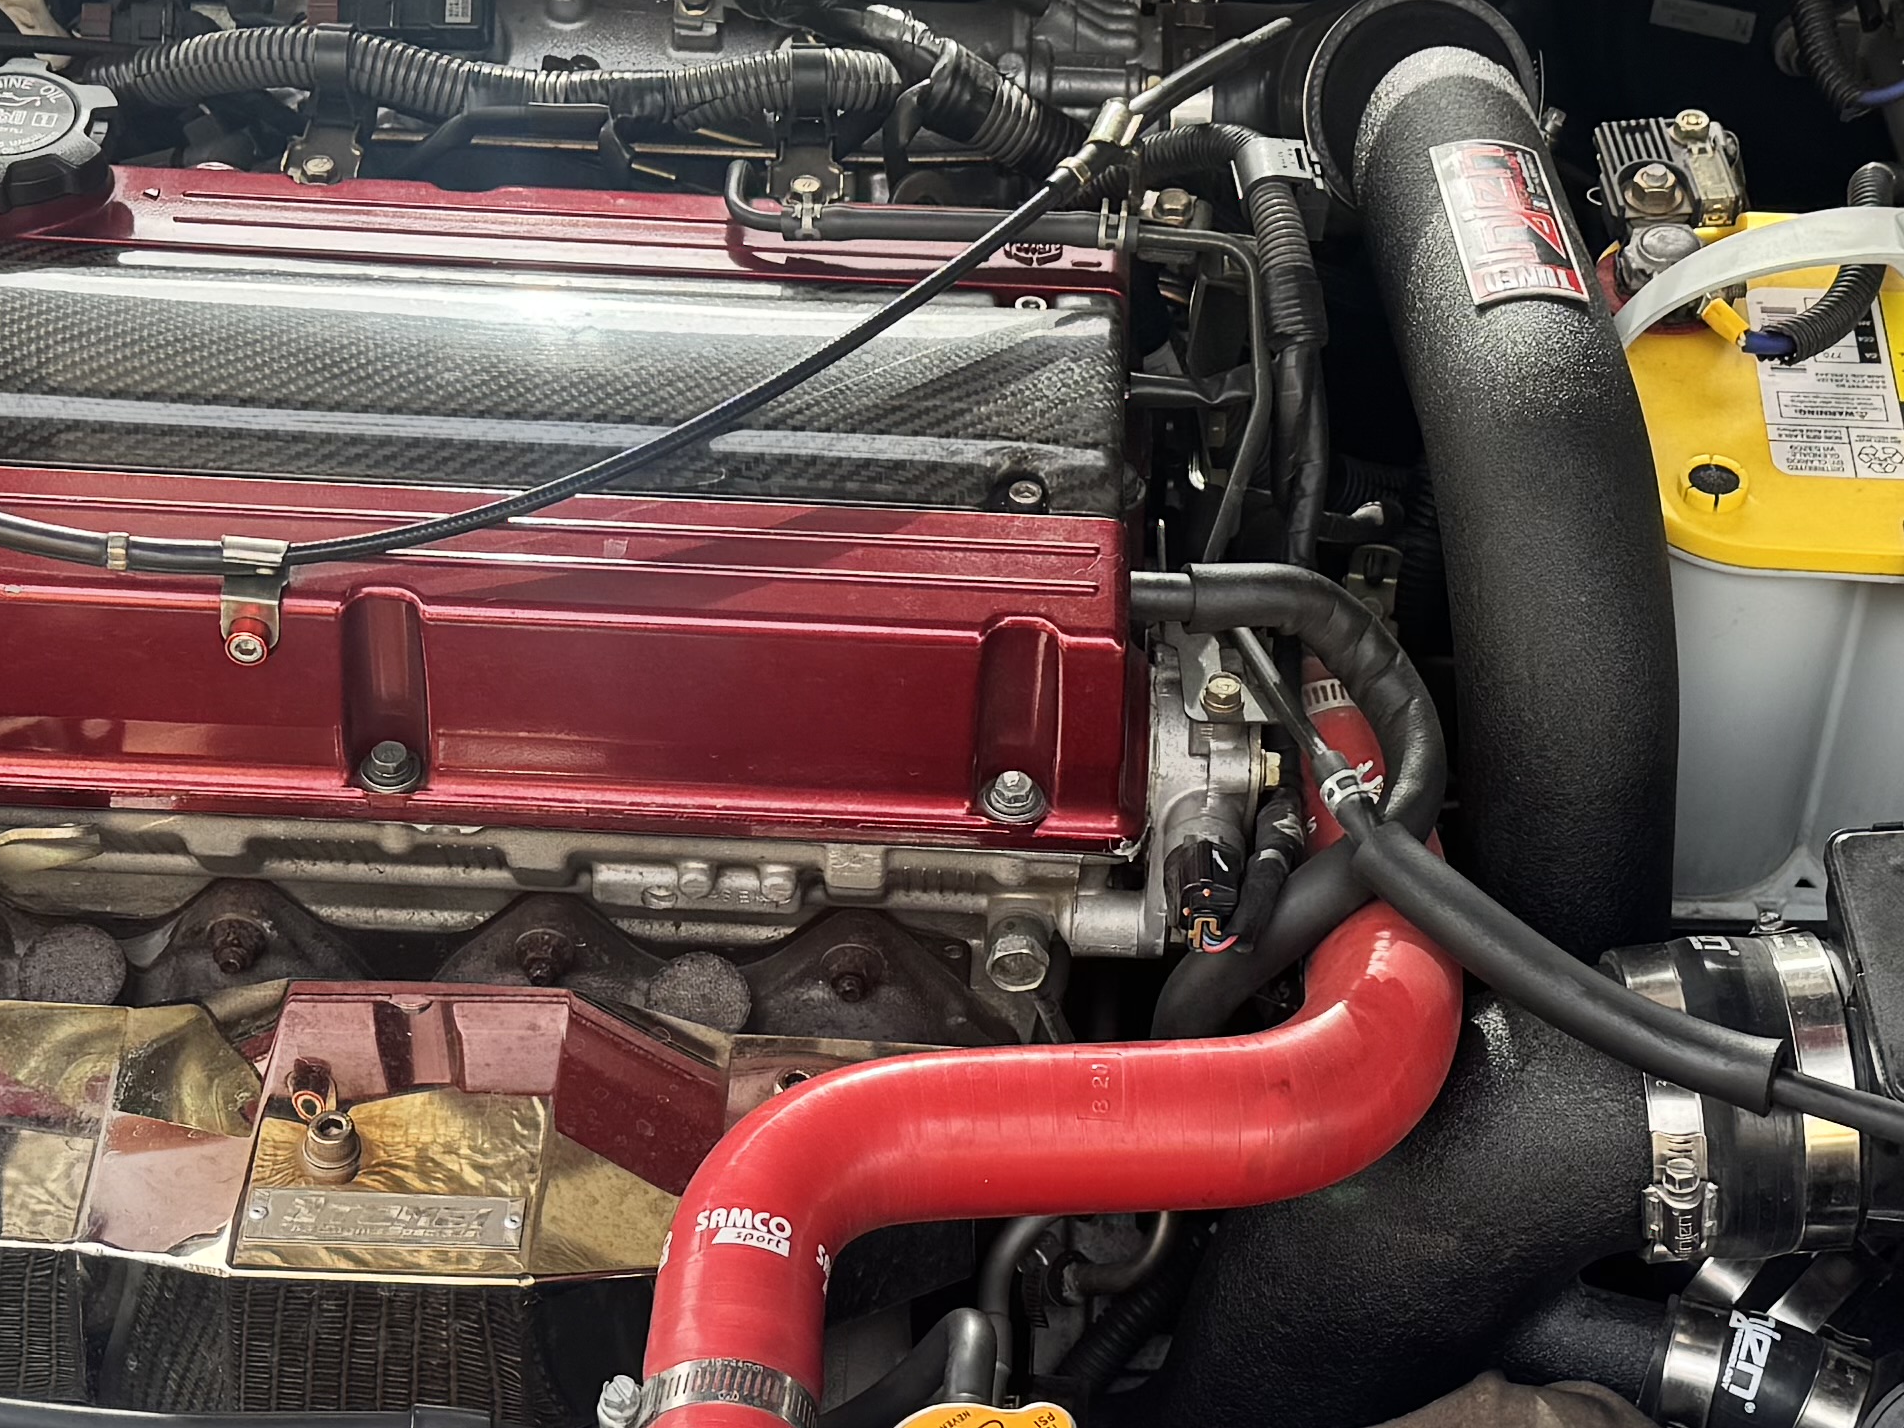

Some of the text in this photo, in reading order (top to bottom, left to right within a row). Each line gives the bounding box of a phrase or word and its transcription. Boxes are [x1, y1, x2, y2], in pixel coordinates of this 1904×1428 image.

[39, 84, 65, 103] OIL
[1484, 266, 1576, 294] TUNED
[695, 1207, 793, 1240] SAMCO
[735, 1230, 784, 1251] sport
[1033, 1412, 1056, 1428] PSI
